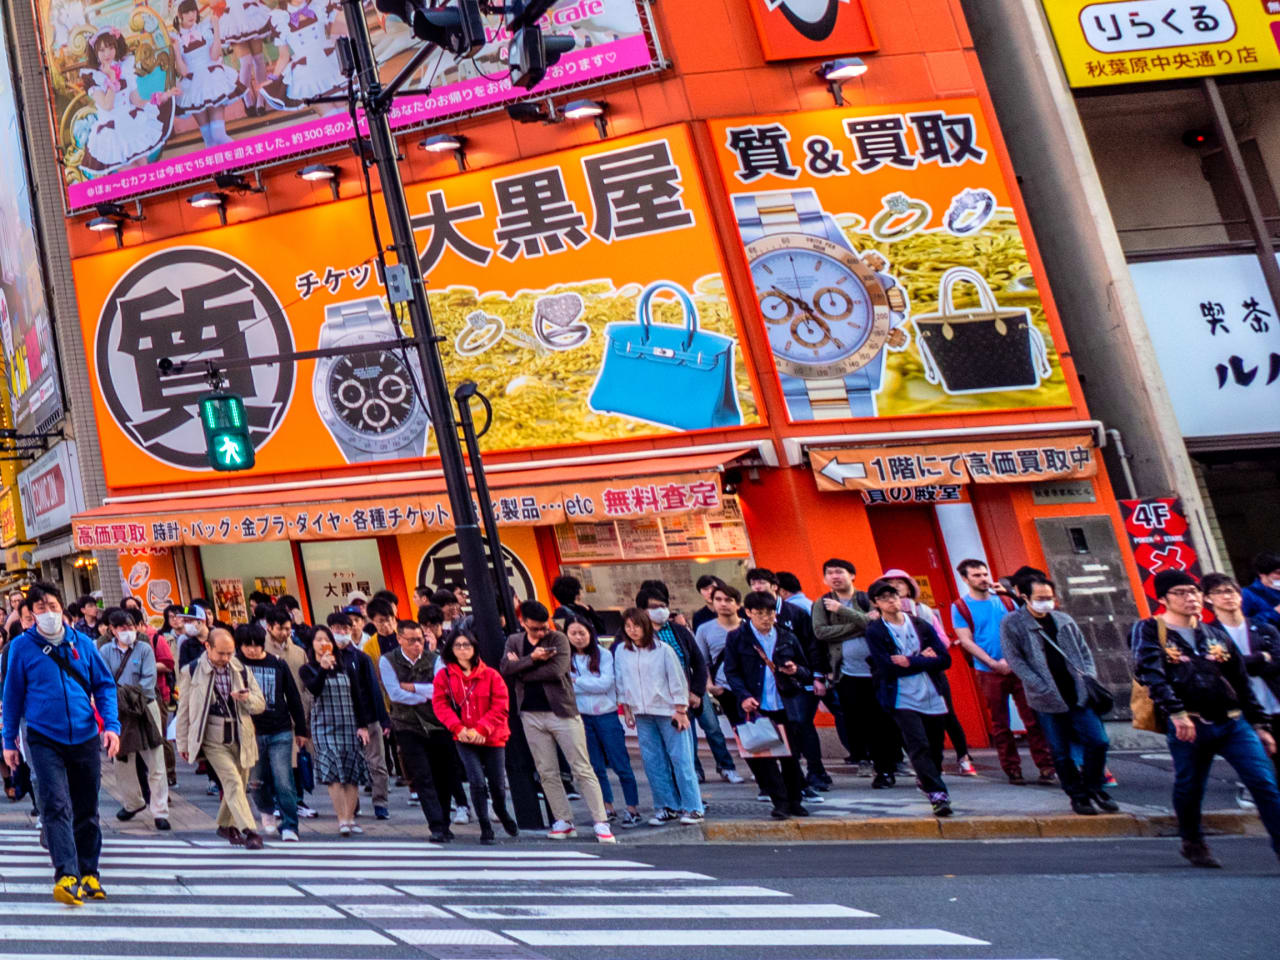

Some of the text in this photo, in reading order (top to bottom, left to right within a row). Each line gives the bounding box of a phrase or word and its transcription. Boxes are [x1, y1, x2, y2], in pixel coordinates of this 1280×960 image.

[1094, 6, 1220, 41] りらくる
[1085, 46, 1258, 78] 秋葉原中央通り店
[412, 138, 696, 274] 大黒屋
[1200, 296, 1271, 336] 喫茶
[118, 268, 281, 446] 質
[870, 445, 1091, 483] 1階にて高価買取中
[76, 481, 720, 546] 高価買取 無料査定
[1132, 503, 1173, 529] 4F
